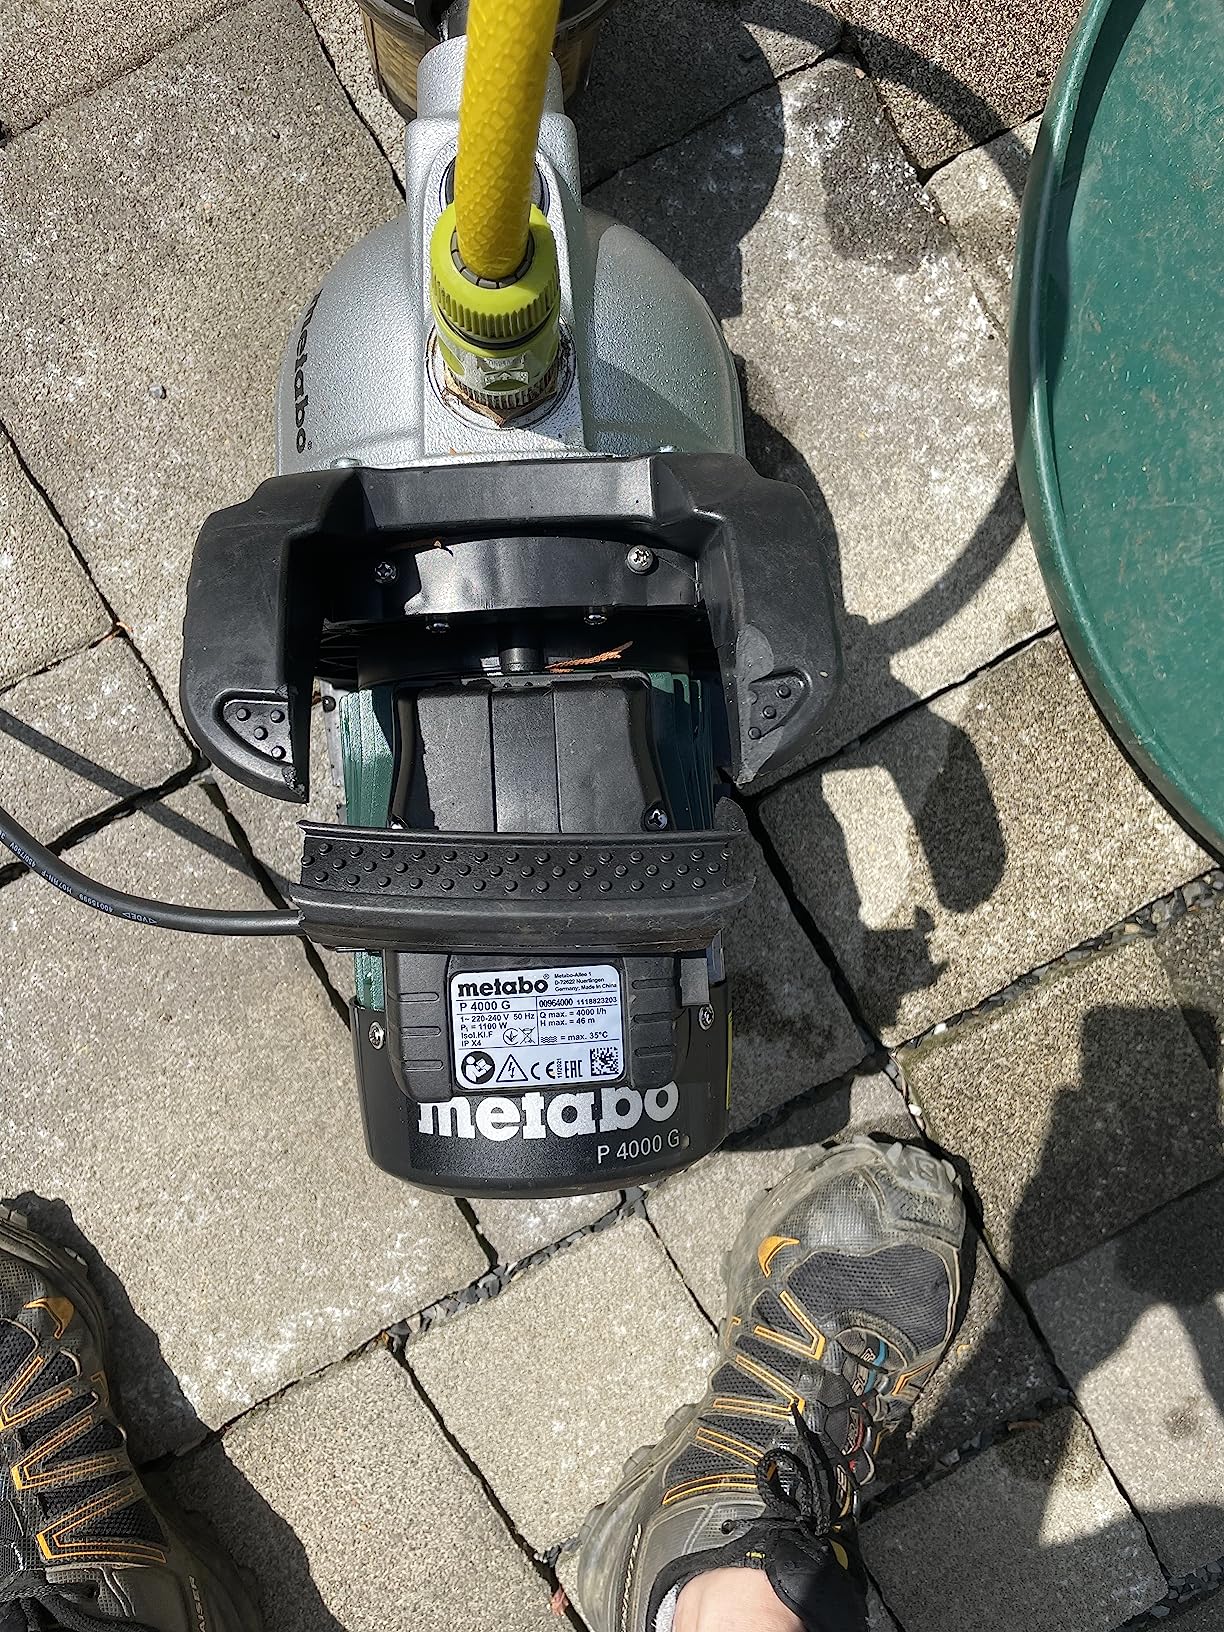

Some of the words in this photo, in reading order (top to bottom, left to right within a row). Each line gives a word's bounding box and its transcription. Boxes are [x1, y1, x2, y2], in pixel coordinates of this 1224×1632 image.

[294, 288, 323, 454] metabo
[458, 976, 549, 998] metabo
[460, 1002, 468, 1012] P
[470, 1001, 498, 1011] 4000
[501, 1000, 511, 1010] G
[590, 1031, 608, 1039] 35°C
[530, 1060, 556, 1080] CE
[564, 1060, 584, 1078] EAC
[417, 1080, 679, 1142] metabo
[597, 1144, 610, 1164] P
[616, 1134, 663, 1160] 4000
[667, 1128, 681, 1148] G
